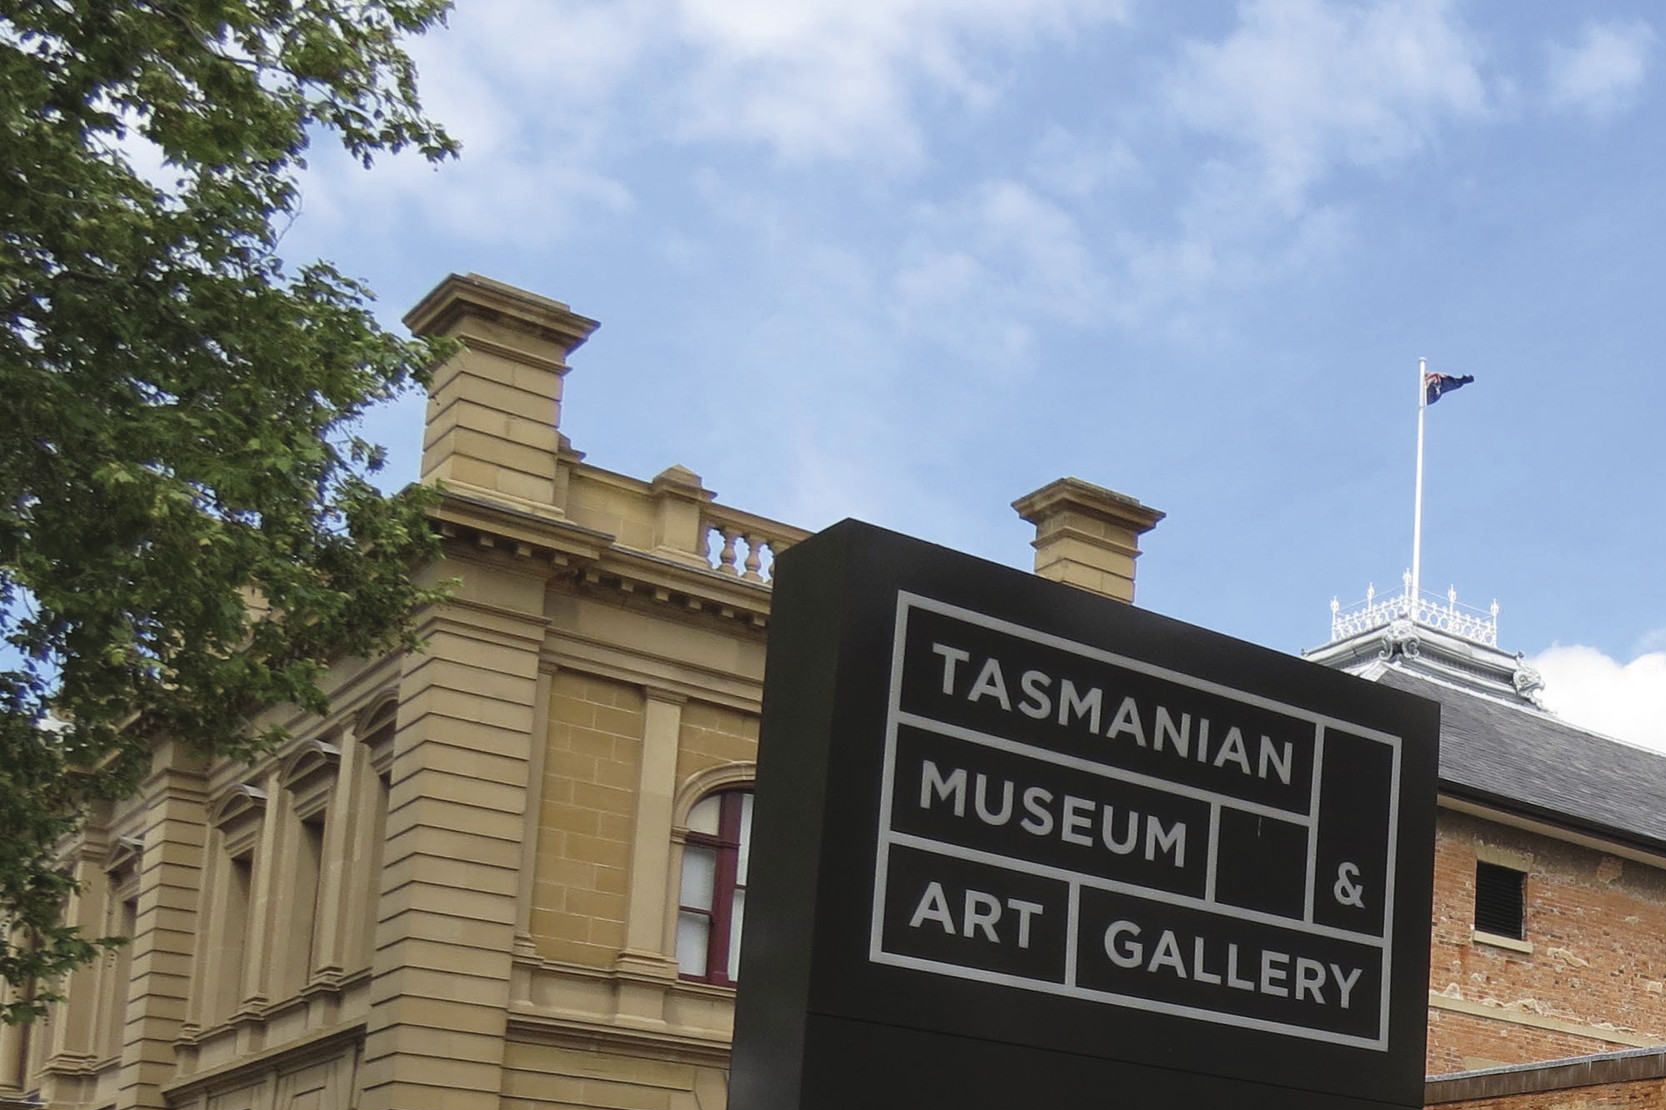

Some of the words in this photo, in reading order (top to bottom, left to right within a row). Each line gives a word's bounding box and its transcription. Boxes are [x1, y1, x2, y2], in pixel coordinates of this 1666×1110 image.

[932, 642, 1294, 785] TASMANIAN
[919, 759, 1187, 868] MUSEUM
[1333, 861, 1366, 909] &
[908, 881, 1044, 949] ART
[1103, 919, 1363, 1009] GALLERY
